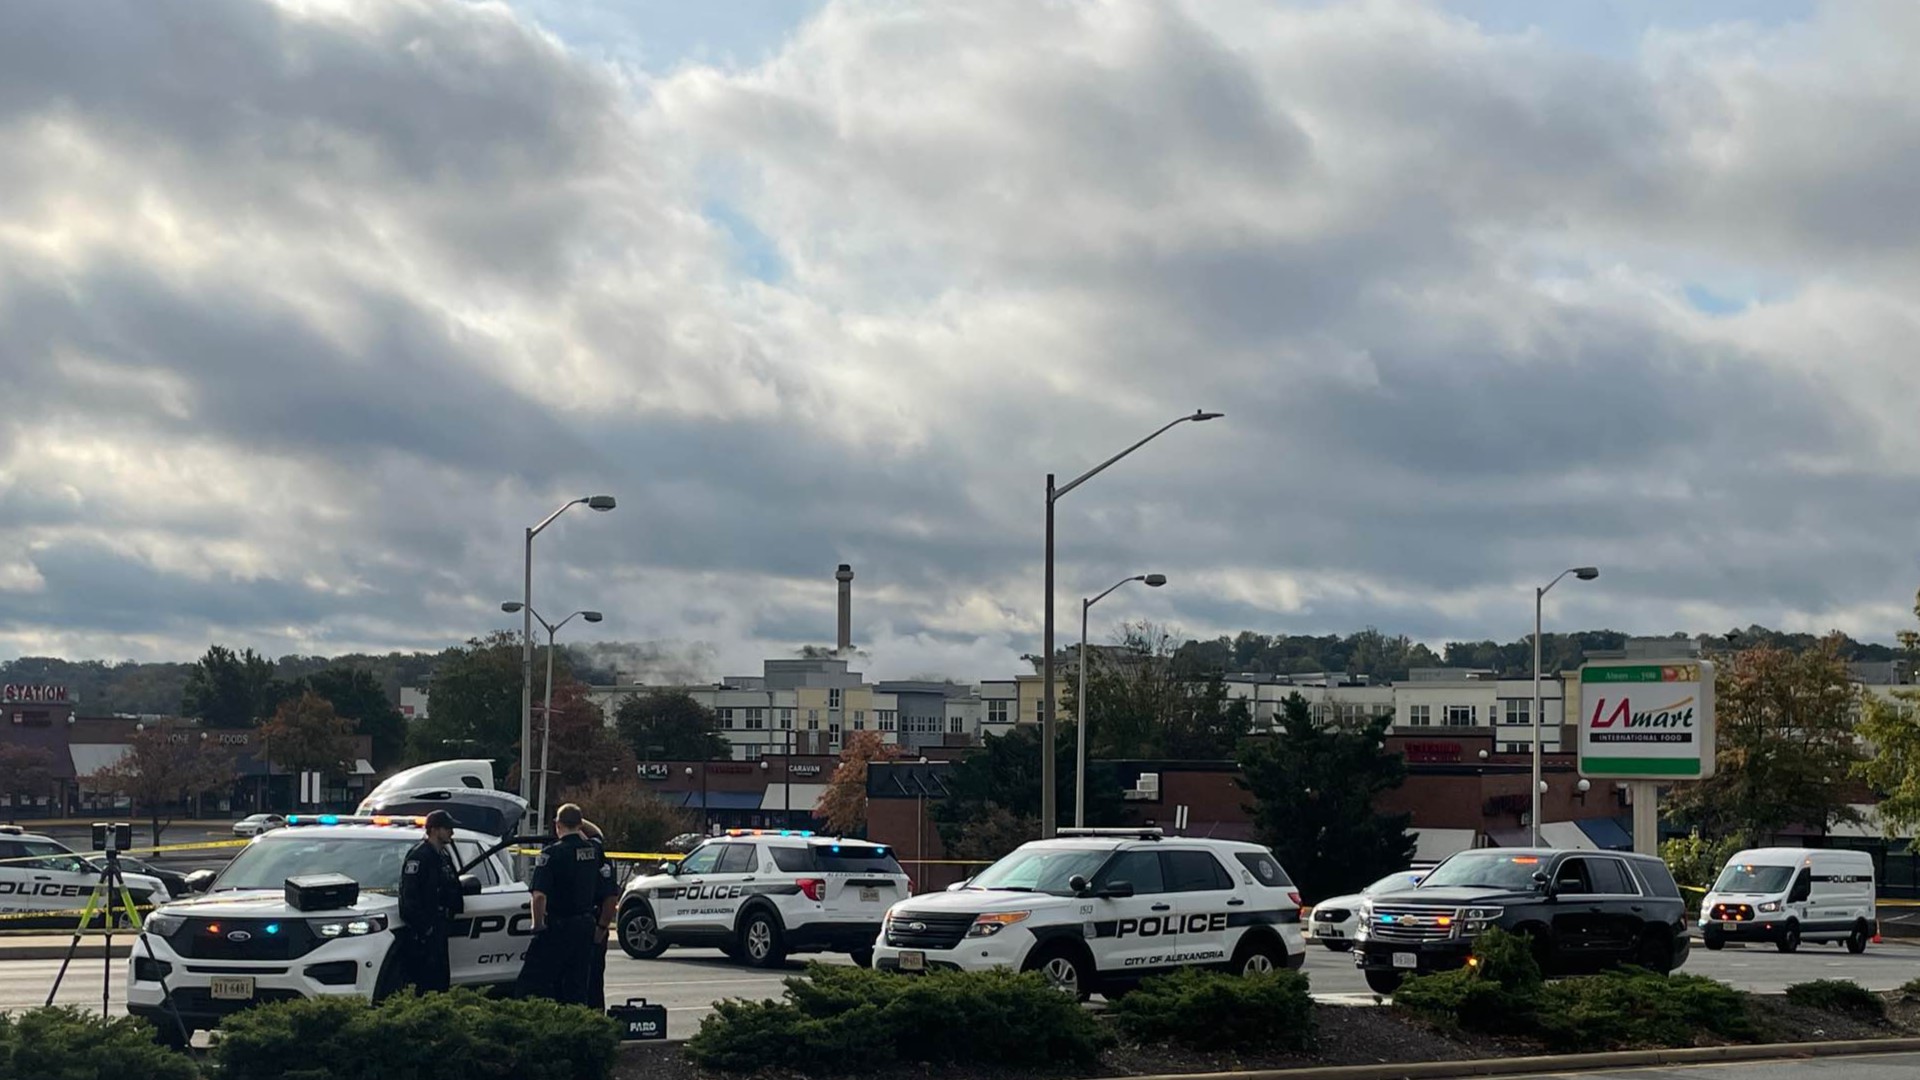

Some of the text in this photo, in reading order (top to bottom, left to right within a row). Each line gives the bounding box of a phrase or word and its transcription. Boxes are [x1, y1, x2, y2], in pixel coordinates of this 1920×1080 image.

[4, 684, 66, 700] STATION
[219, 734, 248, 744] FOODS
[1599, 734, 1682, 742] INTERNATIONAL FOOD
[788, 765, 820, 773] CARAVAN
[1828, 875, 1857, 883] POLICE
[0, 882, 79, 897] OLICE
[674, 885, 742, 901] POLICE
[1117, 914, 1226, 938] POLICE
[478, 952, 514, 964] CITY
[1124, 951, 1225, 967] CITY OF ALEXANDRIA
[629, 1021, 655, 1031] FARO
